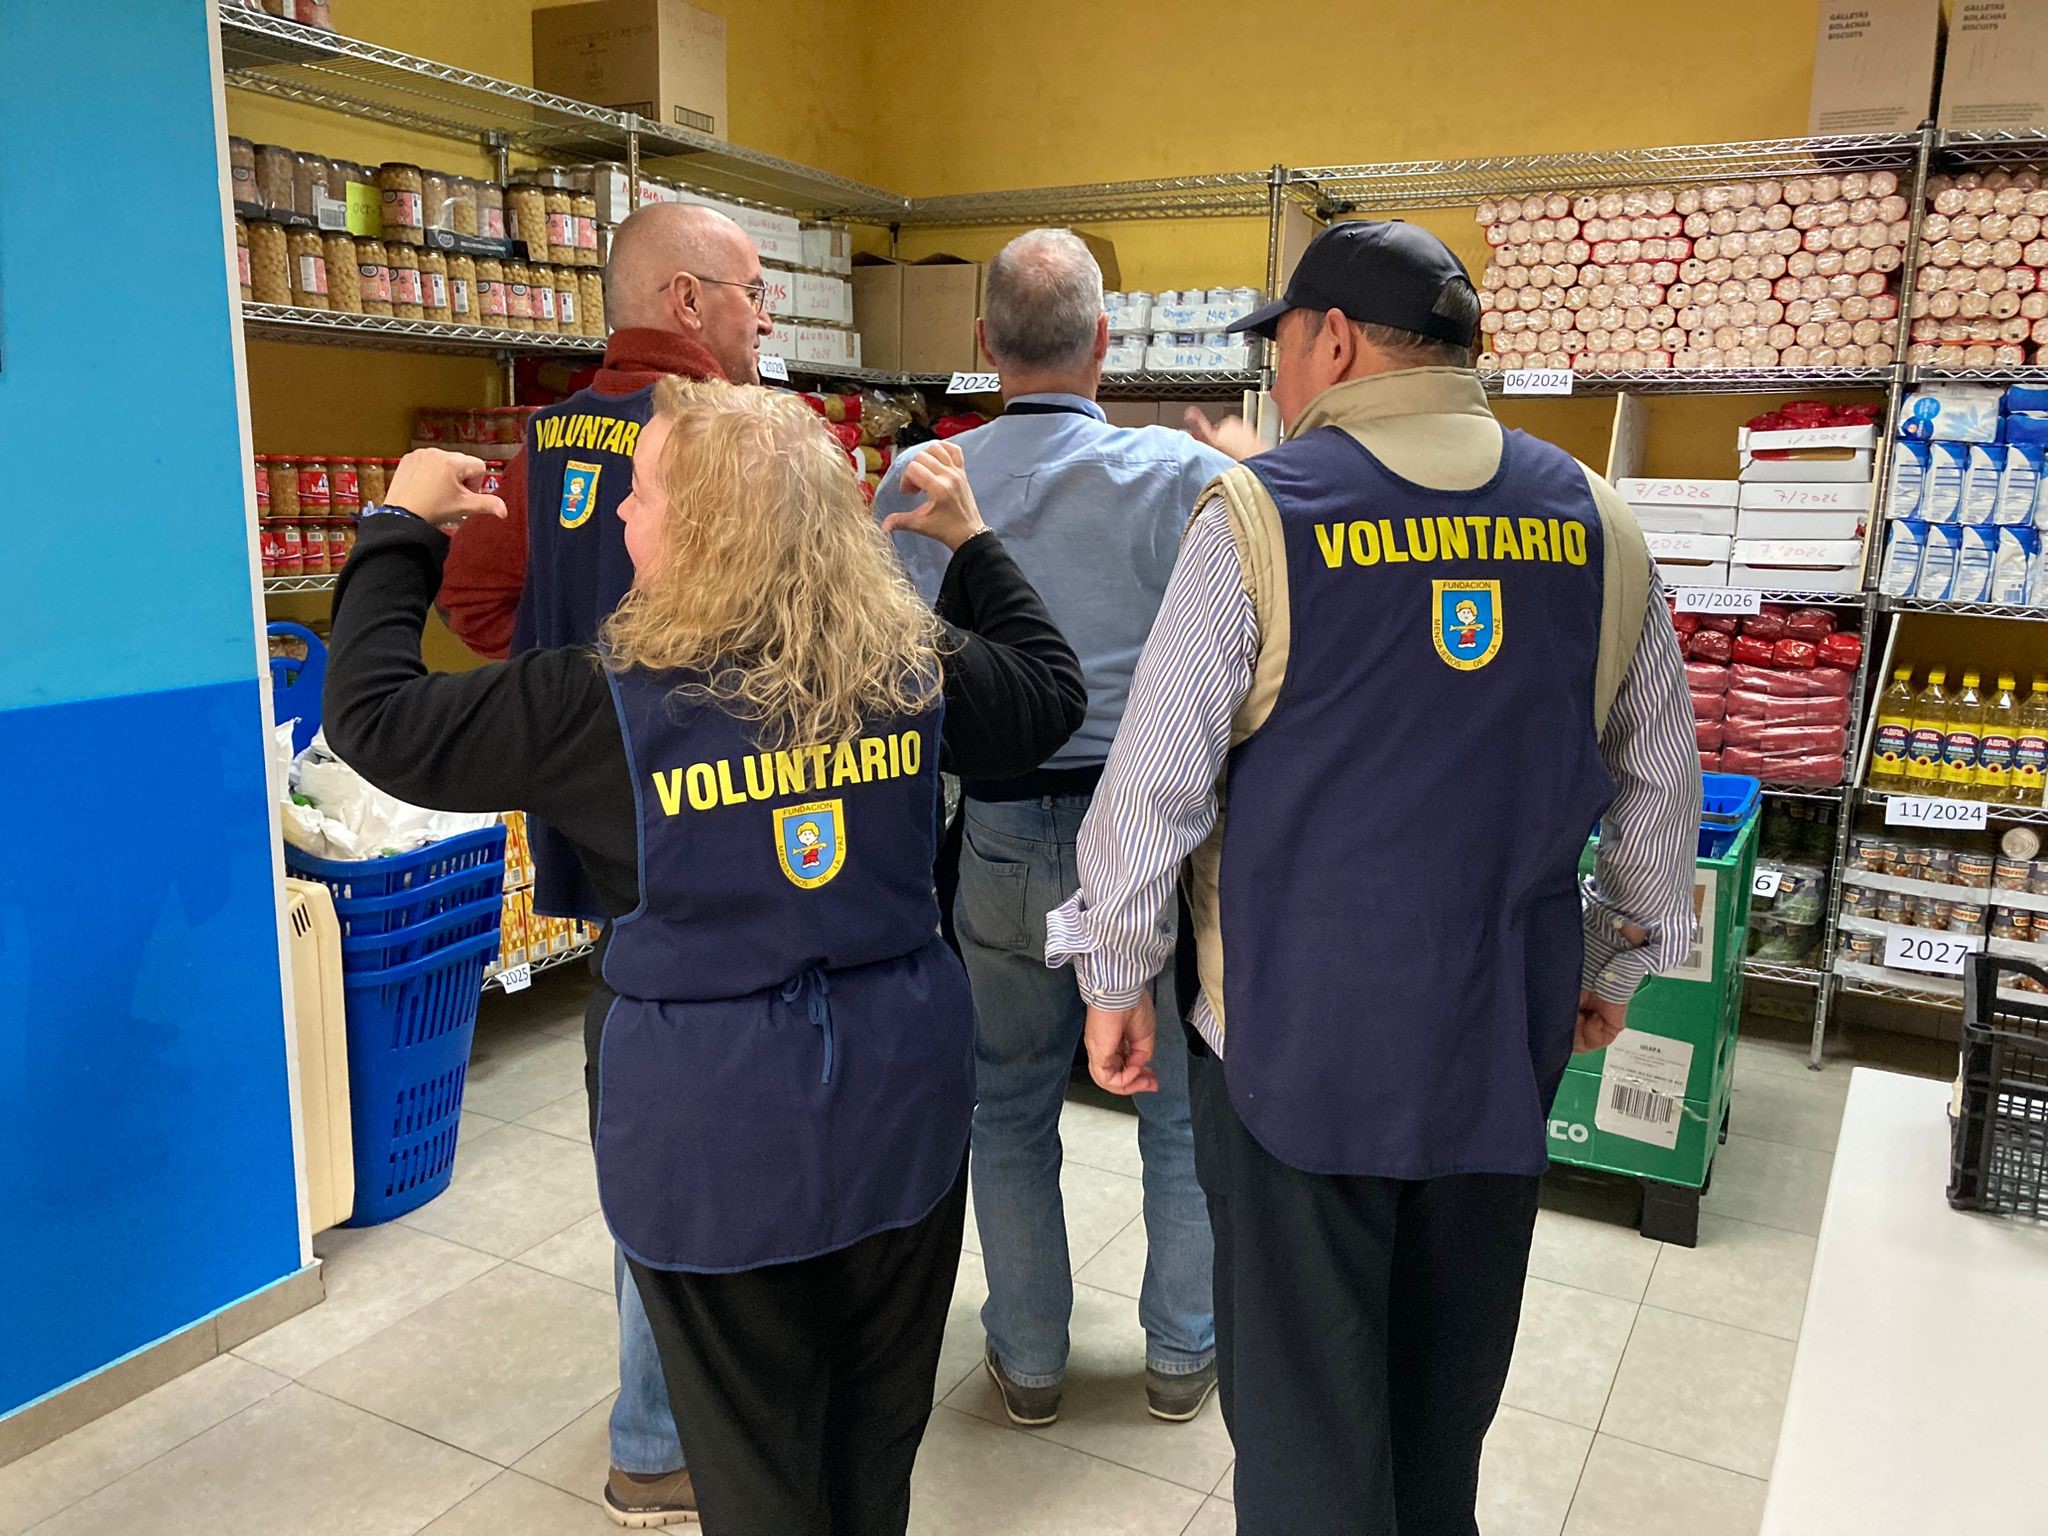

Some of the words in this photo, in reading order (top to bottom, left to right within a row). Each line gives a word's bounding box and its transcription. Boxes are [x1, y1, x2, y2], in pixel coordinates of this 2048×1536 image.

[1830, 11, 1869, 20] GALLETAS
[1962, 23, 1998, 31] BISCUITS
[1828, 31, 1862, 40] BISCUITS
[951, 377, 1000, 390] 2026
[1506, 373, 1568, 388] 06/2024
[535, 414, 640, 457] VOLUNTAR
[1635, 483, 1712, 498] 7/2026
[1774, 489, 1838, 504] 7/2026
[1314, 516, 1587, 568] VOLUNTARIO
[1443, 581, 1491, 589] FUNDACION
[1687, 592, 1753, 608] 07/2026
[1434, 618, 1461, 668] MENSAJEROS
[1473, 658, 1485, 668] DE
[1488, 644, 1498, 655] LA
[1882, 728, 1906, 737] ABRIL
[1915, 732, 1939, 741] ABRIL
[1950, 735, 1975, 745] ABRIL
[1986, 739, 2011, 748] ABRIL
[2020, 740, 2045, 749] ABRIL
[652, 730, 921, 816] VOLUNTARIO
[783, 802, 833, 816] FUNDACION
[1899, 802, 1983, 821] 11/2024
[778, 845, 809, 887] MENSAJEROS
[818, 875, 830, 884] DE
[833, 859, 841, 870] LA
[1755, 874, 1773, 890] 6
[1900, 938, 1969, 965] 2027
[500, 967, 529, 986] 2025
[1549, 1119, 1589, 1143] CO
